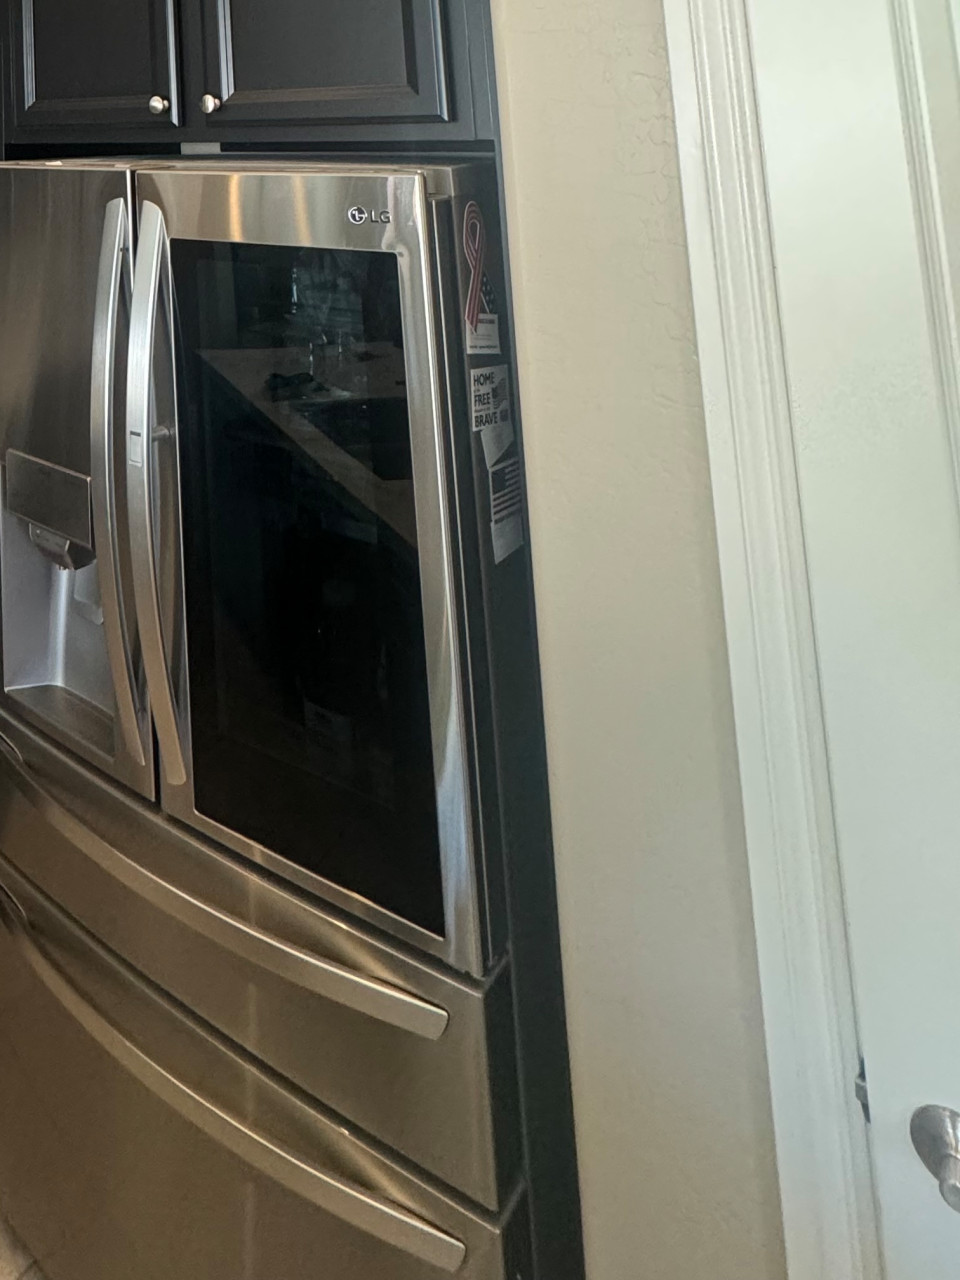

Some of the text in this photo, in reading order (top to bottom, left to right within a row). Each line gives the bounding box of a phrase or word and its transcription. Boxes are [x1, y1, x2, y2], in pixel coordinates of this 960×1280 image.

[370, 209, 392, 224] LG
[473, 371, 495, 387] HOME
[474, 392, 491, 407] FREE
[474, 411, 498, 428] BRAVE
